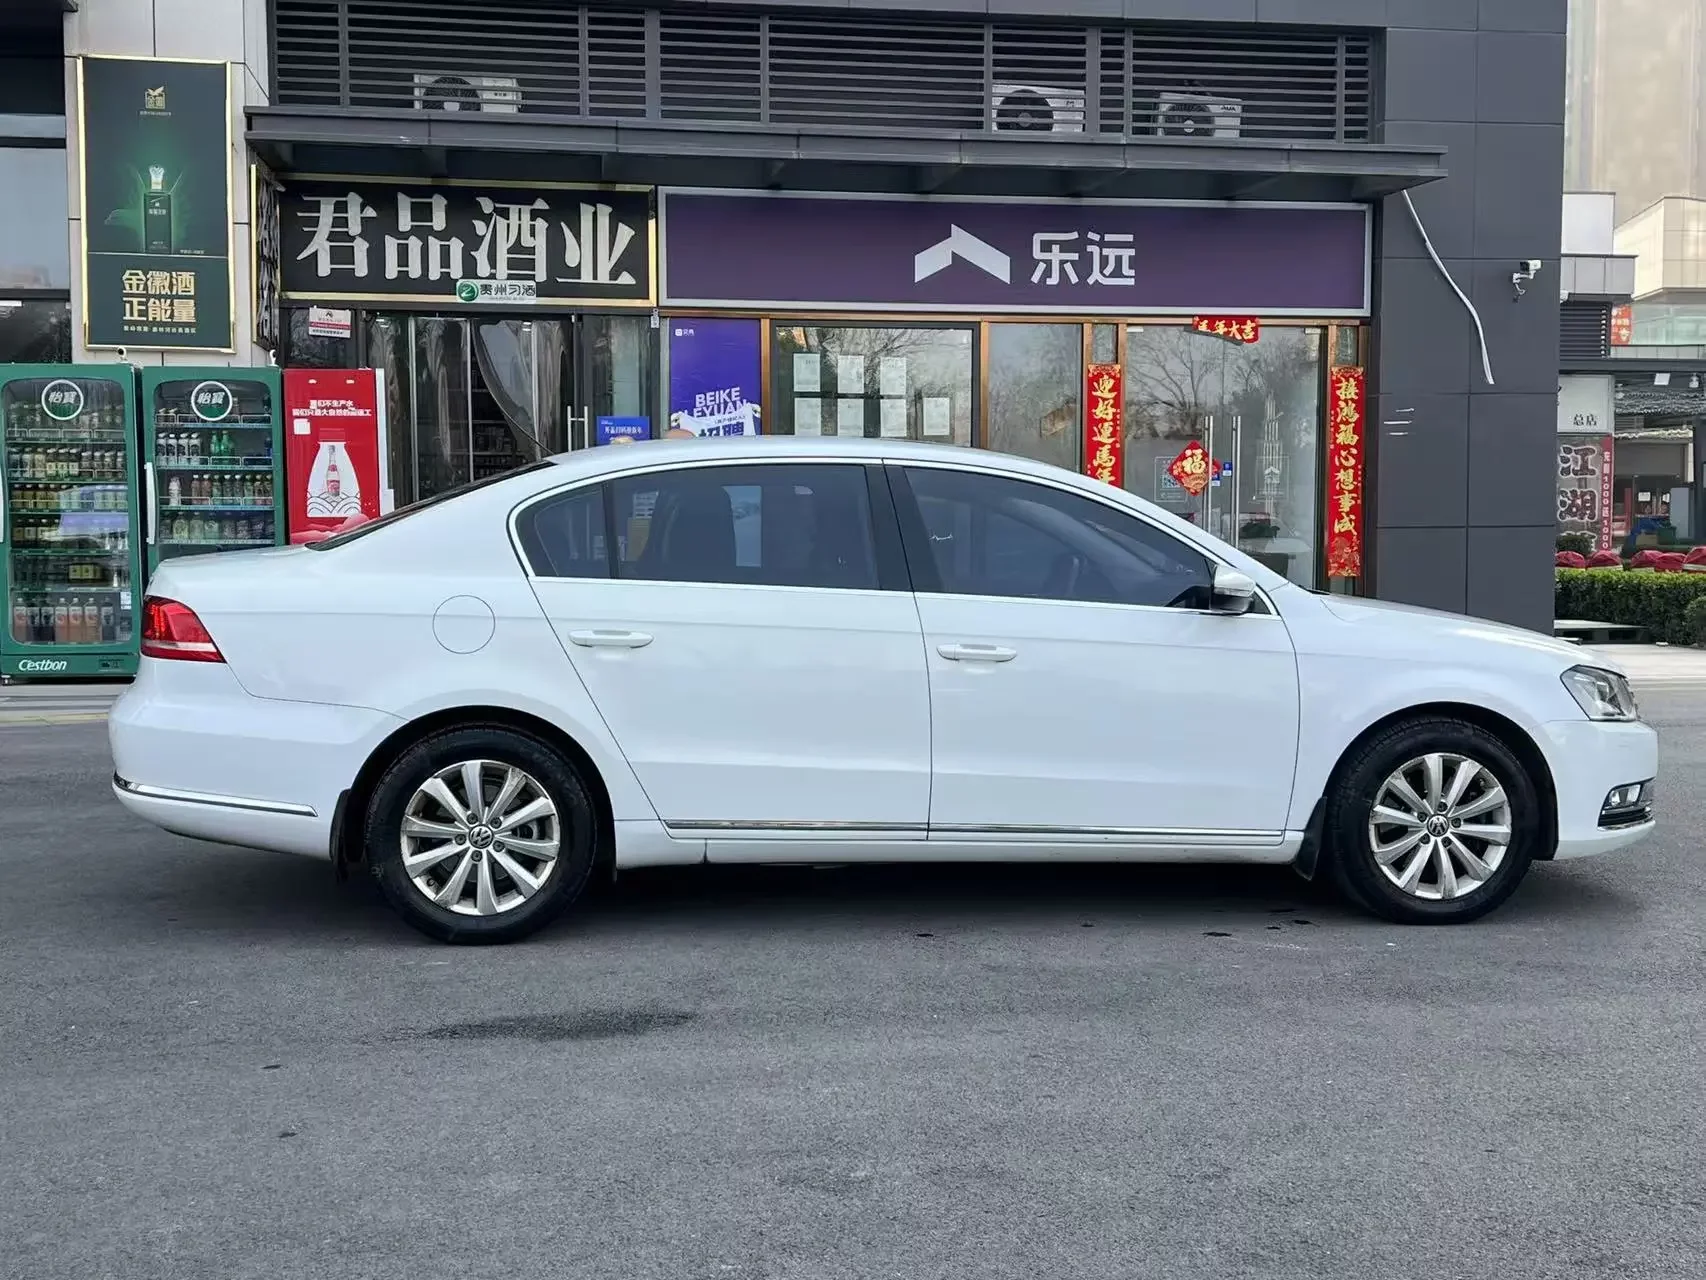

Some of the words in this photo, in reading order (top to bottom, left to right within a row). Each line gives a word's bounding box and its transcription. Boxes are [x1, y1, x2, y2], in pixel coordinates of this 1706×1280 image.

[296, 191, 637, 285] 君品酒业
[1030, 231, 1136, 286] 乐远
[122, 270, 196, 296] 金徽酒
[480, 283, 536, 297] 贵州习酒
[122, 297, 197, 322] 正能量
[310, 399, 354, 408] 们不生产水
[695, 387, 741, 408] BEIKE
[1182, 448, 1206, 474] 福
